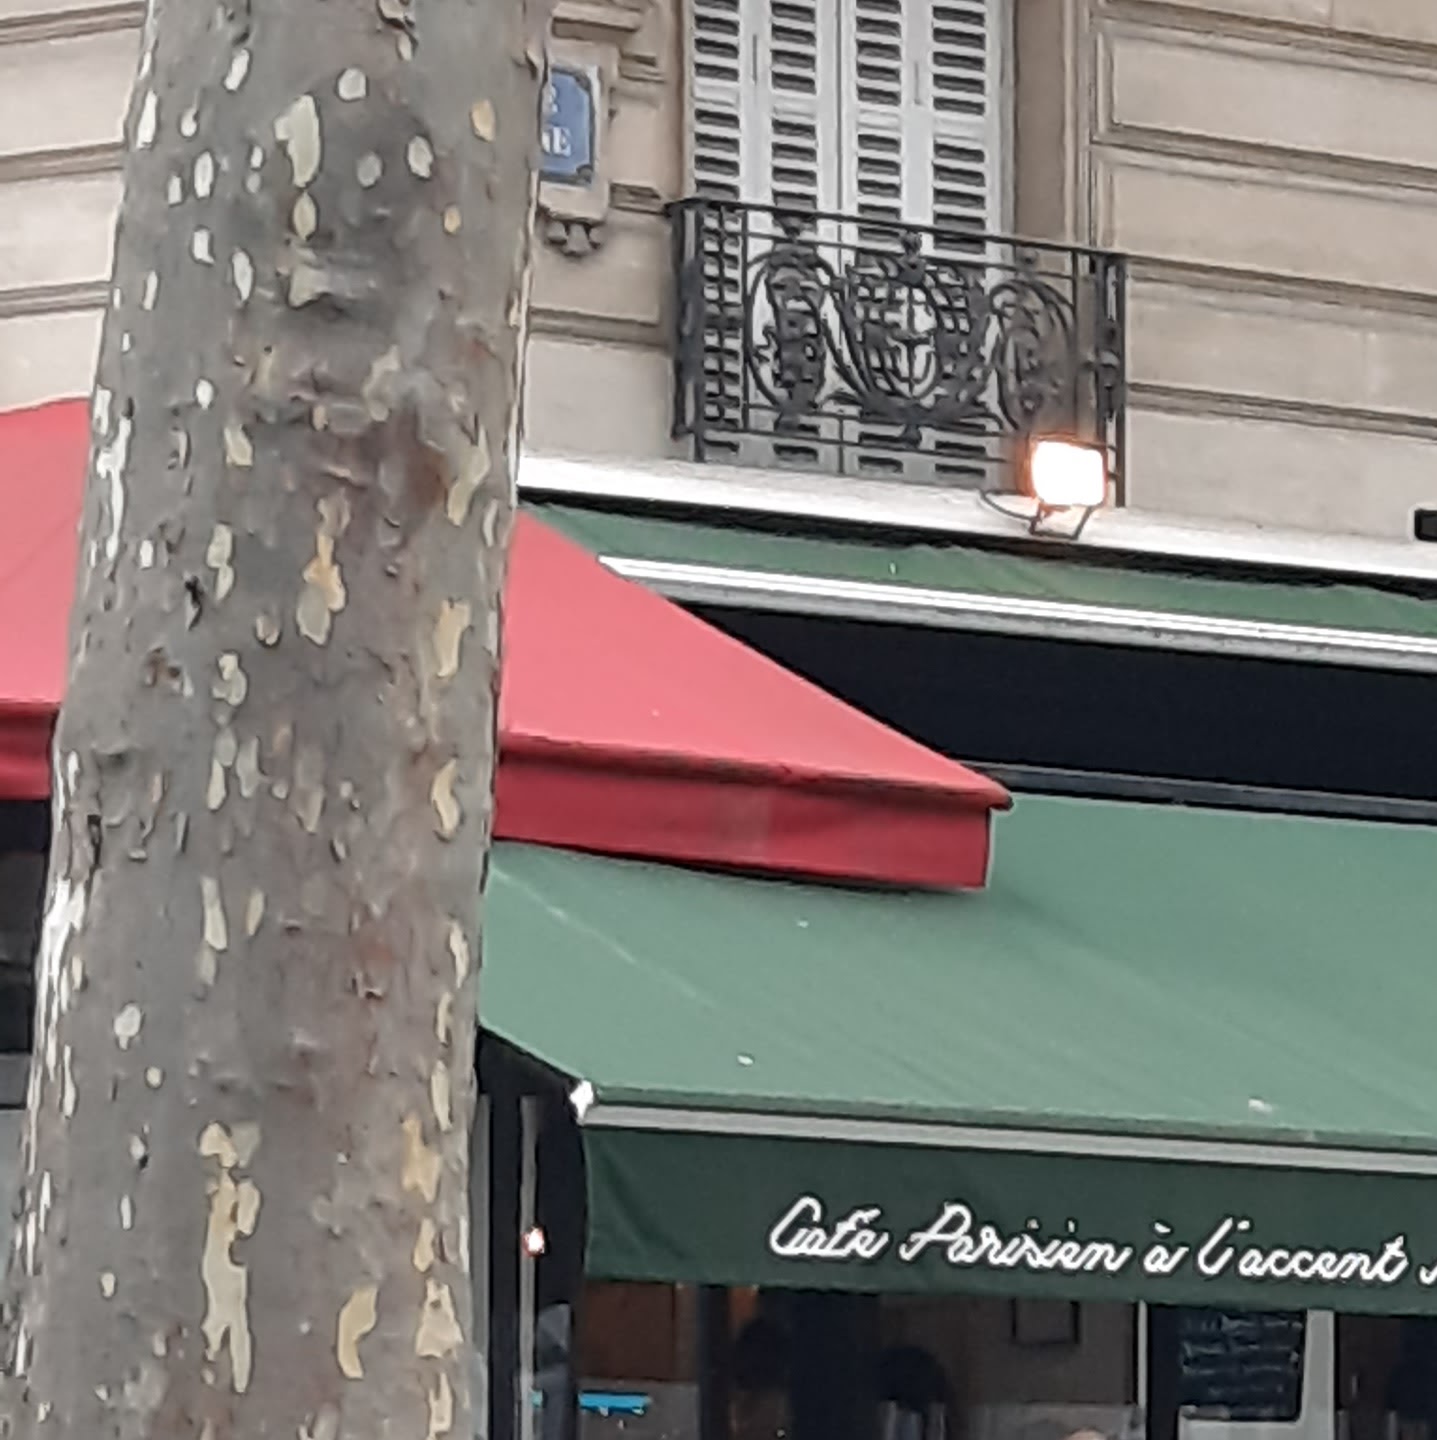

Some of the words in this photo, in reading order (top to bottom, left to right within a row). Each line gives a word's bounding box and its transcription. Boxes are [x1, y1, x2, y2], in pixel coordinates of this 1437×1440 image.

[768, 1195, 890, 1260] Café
[899, 1202, 1133, 1273] Parisien
[1142, 1221, 1190, 1274] à
